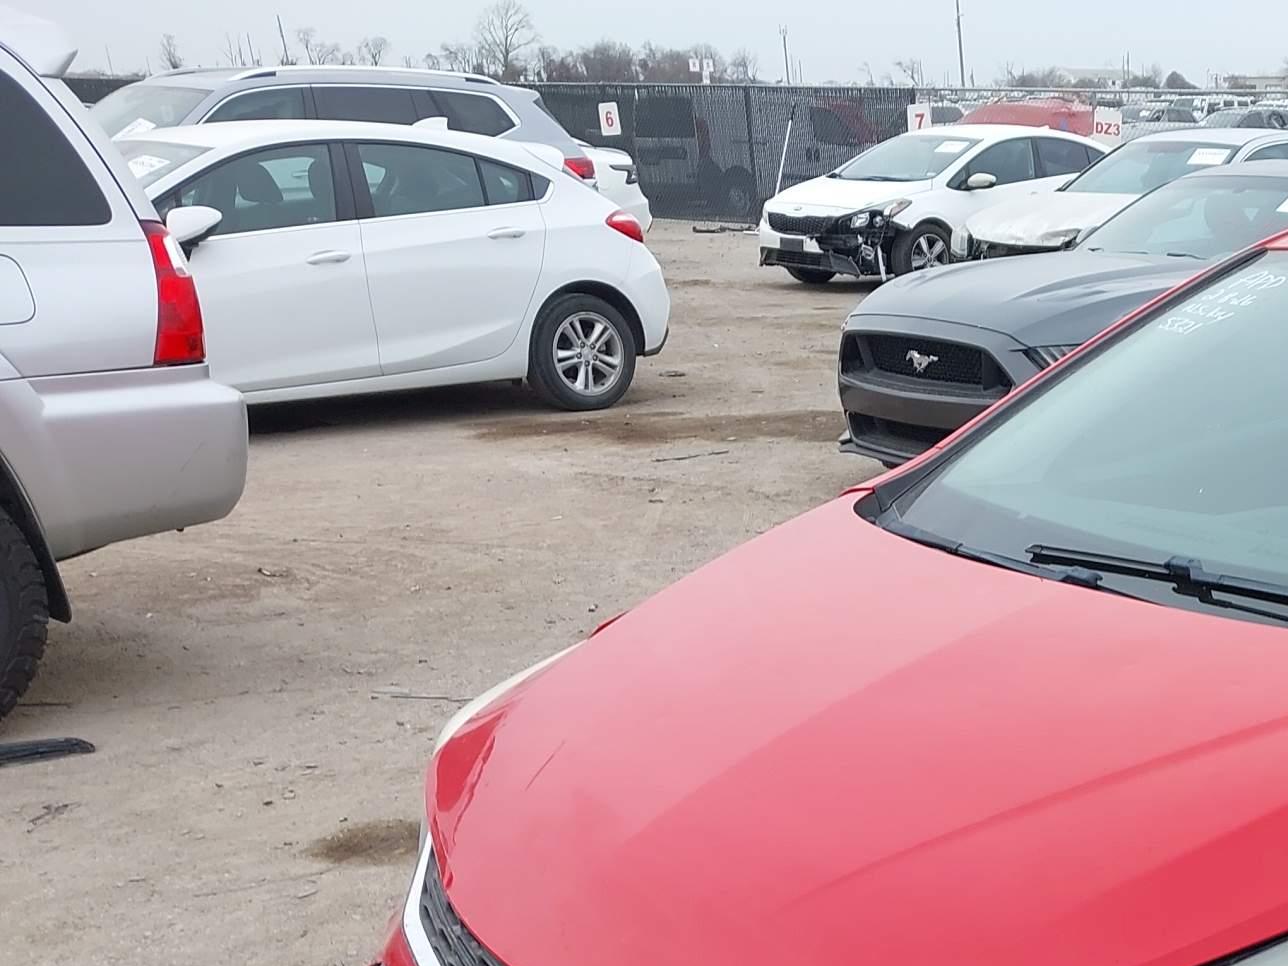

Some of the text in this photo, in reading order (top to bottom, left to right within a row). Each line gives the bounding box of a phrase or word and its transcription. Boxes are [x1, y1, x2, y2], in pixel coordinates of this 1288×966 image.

[605, 110, 614, 128] 6
[914, 112, 925, 130] 7
[1095, 121, 1121, 137] DZ3
